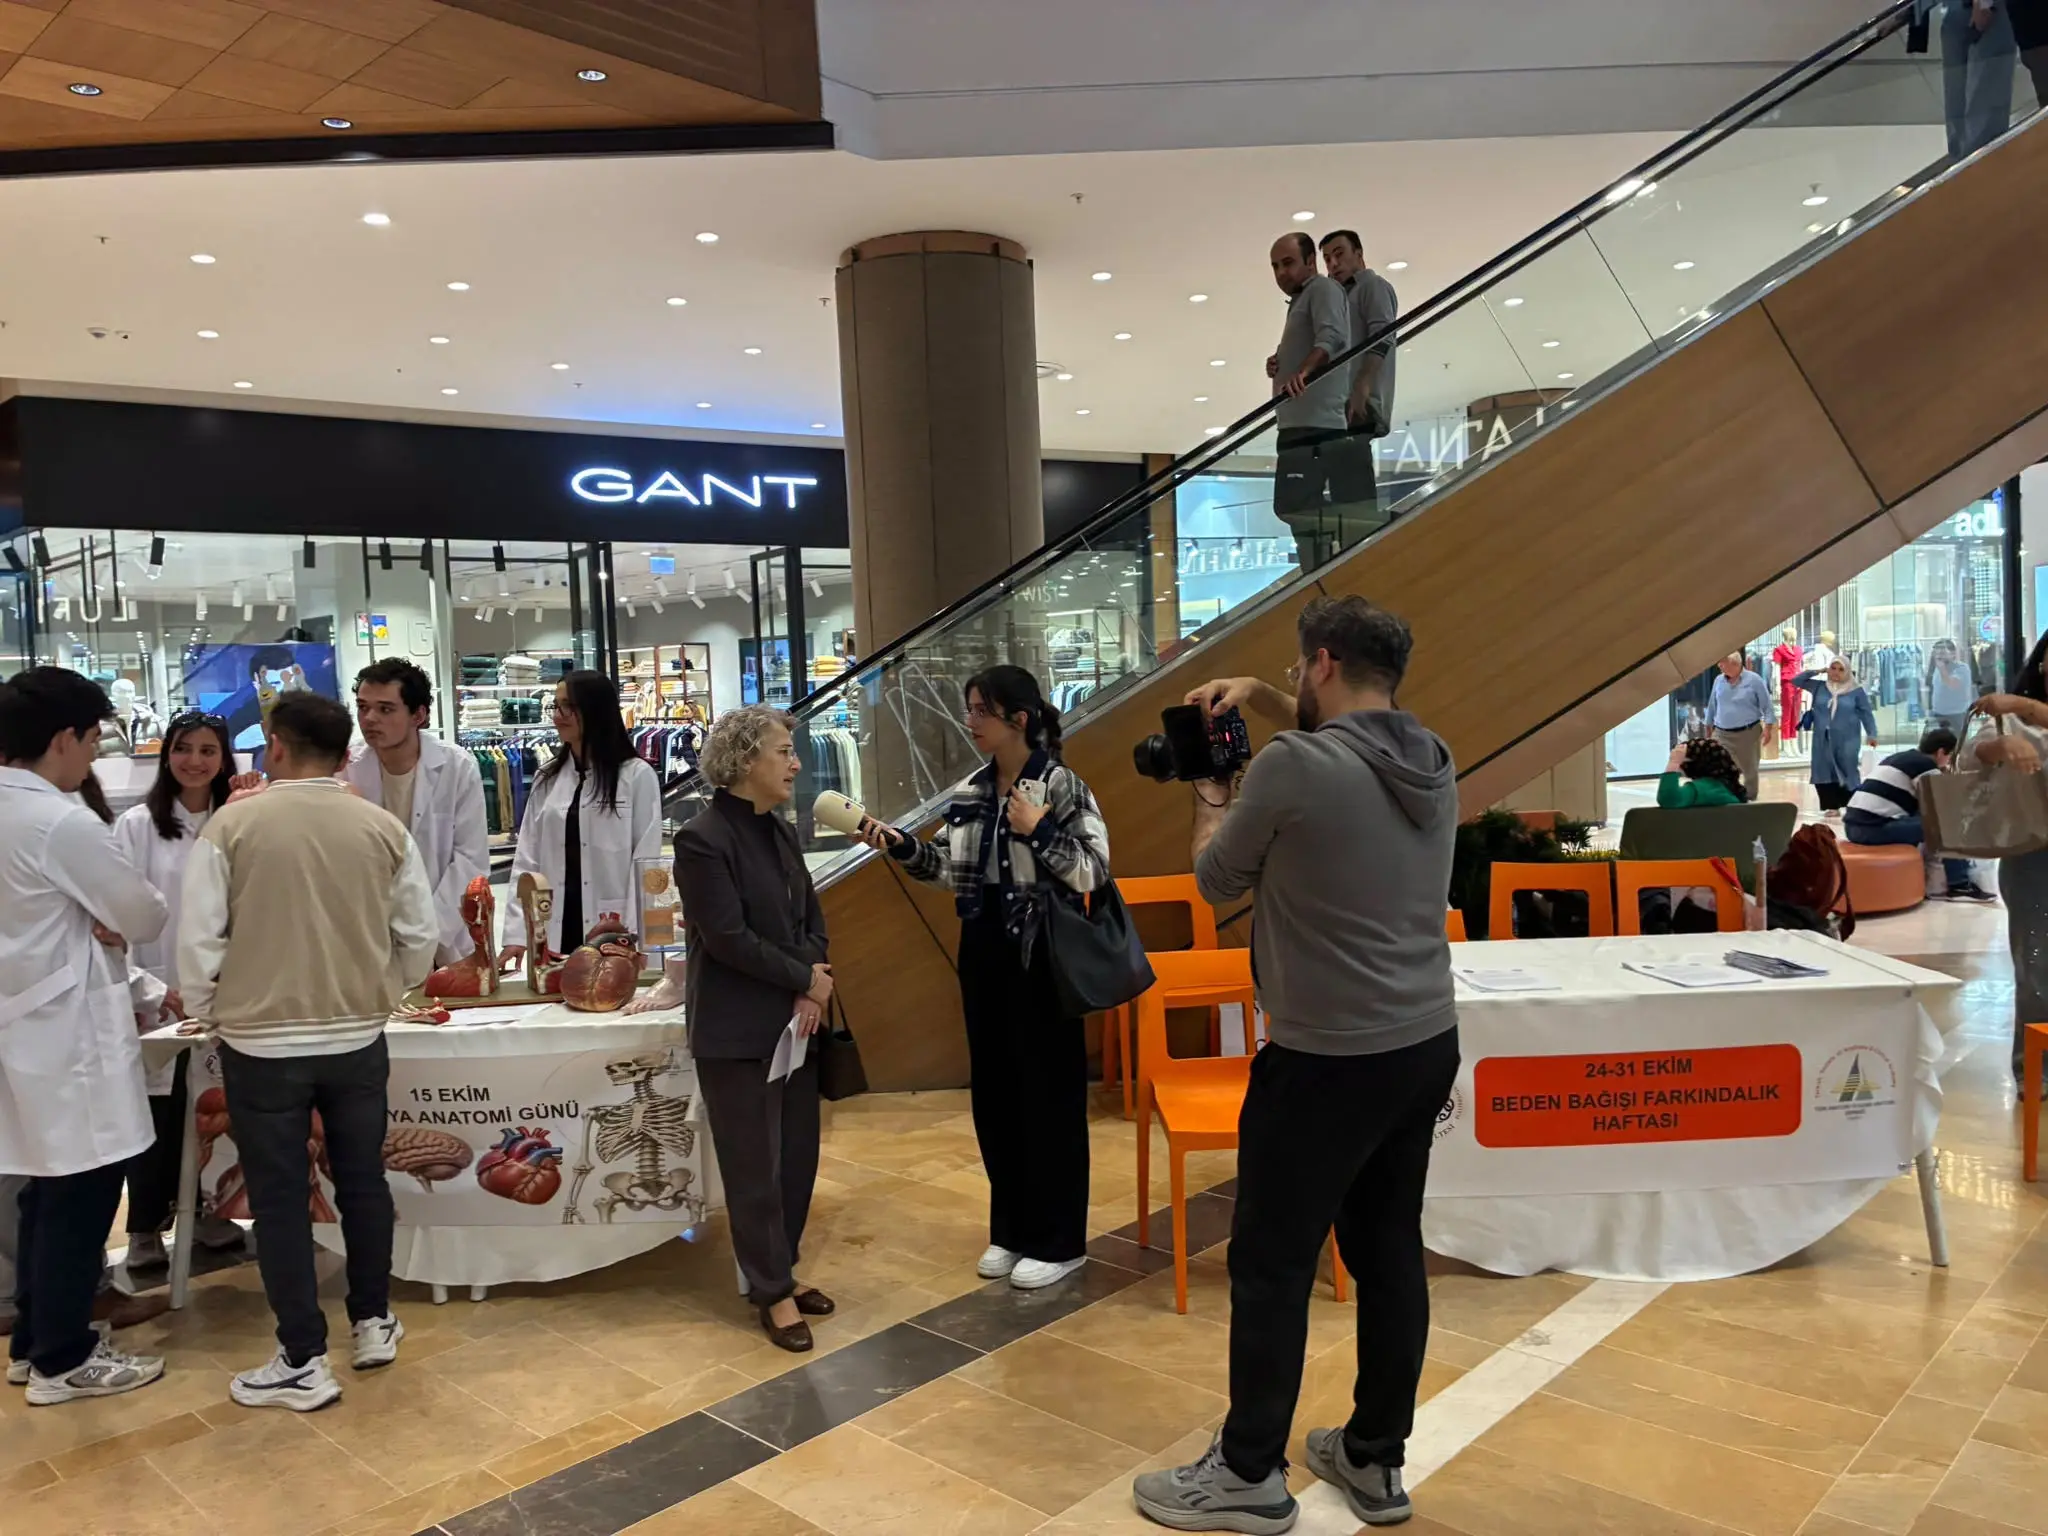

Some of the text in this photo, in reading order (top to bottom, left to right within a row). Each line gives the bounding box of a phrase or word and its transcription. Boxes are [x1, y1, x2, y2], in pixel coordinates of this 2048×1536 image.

[571, 467, 817, 509] GANT
[1585, 1056, 1692, 1078] 24-31 EKİM
[409, 1085, 491, 1102] 15 EKİM
[1492, 1084, 1780, 1112] BEDEN BAĞIŞI FARKINDALIK
[386, 1100, 579, 1124] YA ANATOMİ GÜNÜ
[1593, 1113, 1678, 1131] HAFTASI
